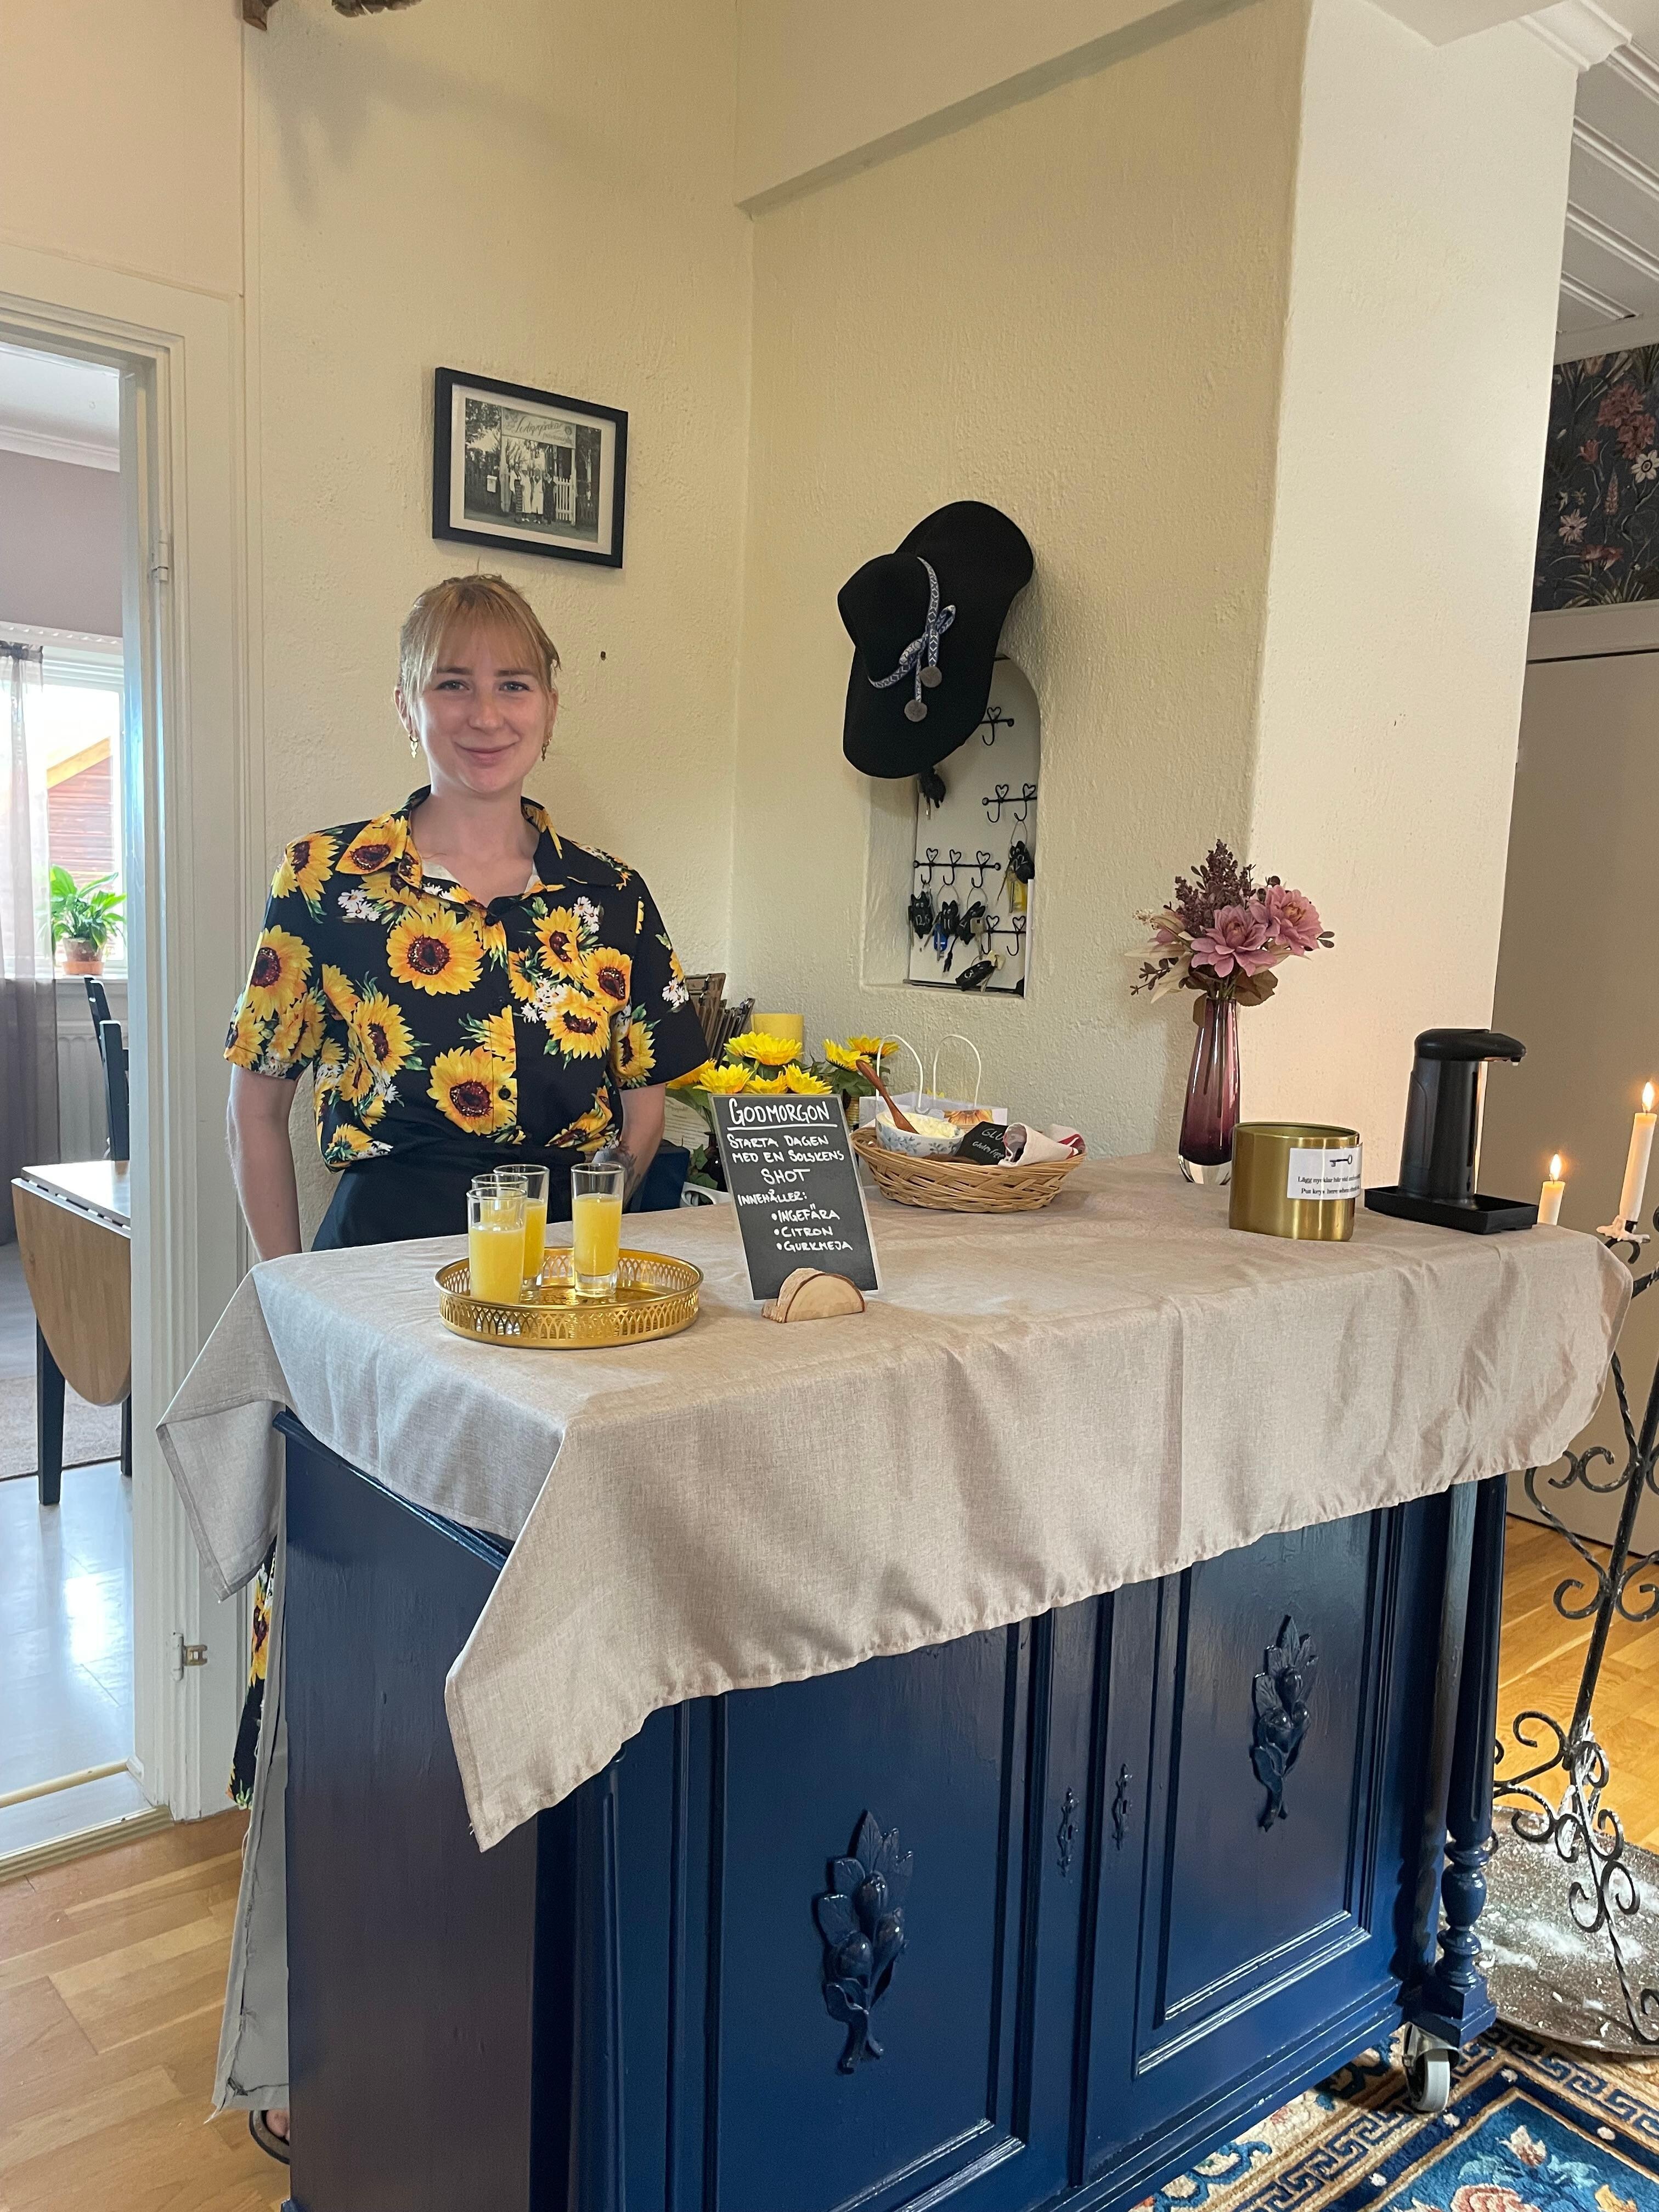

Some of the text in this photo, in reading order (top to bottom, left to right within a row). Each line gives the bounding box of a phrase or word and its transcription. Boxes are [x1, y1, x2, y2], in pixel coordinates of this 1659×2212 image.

[729, 1097, 830, 1126] GODMORGON
[726, 1133, 830, 1149] STARTA DAGEN
[732, 1149, 845, 1164] MED EN SOLSKENS
[760, 1168, 811, 1186] SHOT
[737, 1189, 808, 1207] INNEHÅLLER:
